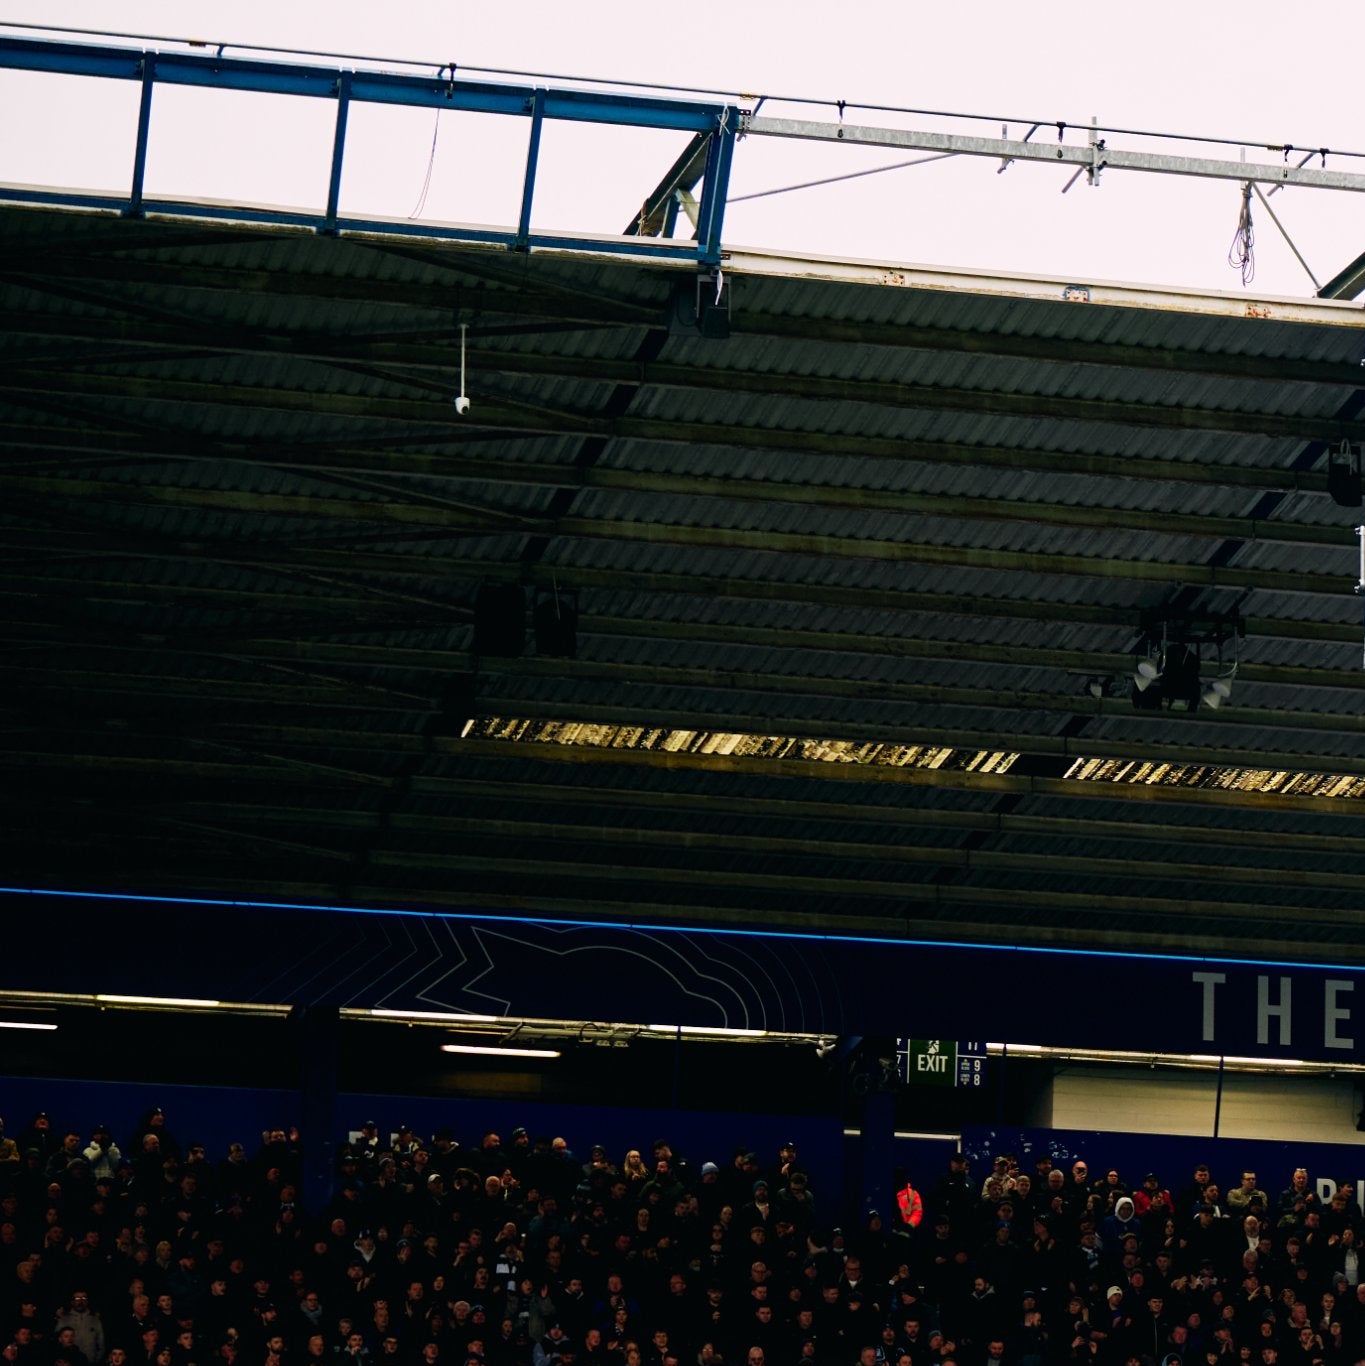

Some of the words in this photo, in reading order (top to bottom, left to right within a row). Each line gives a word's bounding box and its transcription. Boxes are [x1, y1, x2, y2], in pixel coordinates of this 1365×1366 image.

[1192, 971, 1356, 1050] THE
[917, 1053, 949, 1073] EXIT
[973, 1060, 981, 1072] 9
[973, 1073, 981, 1086] 8
